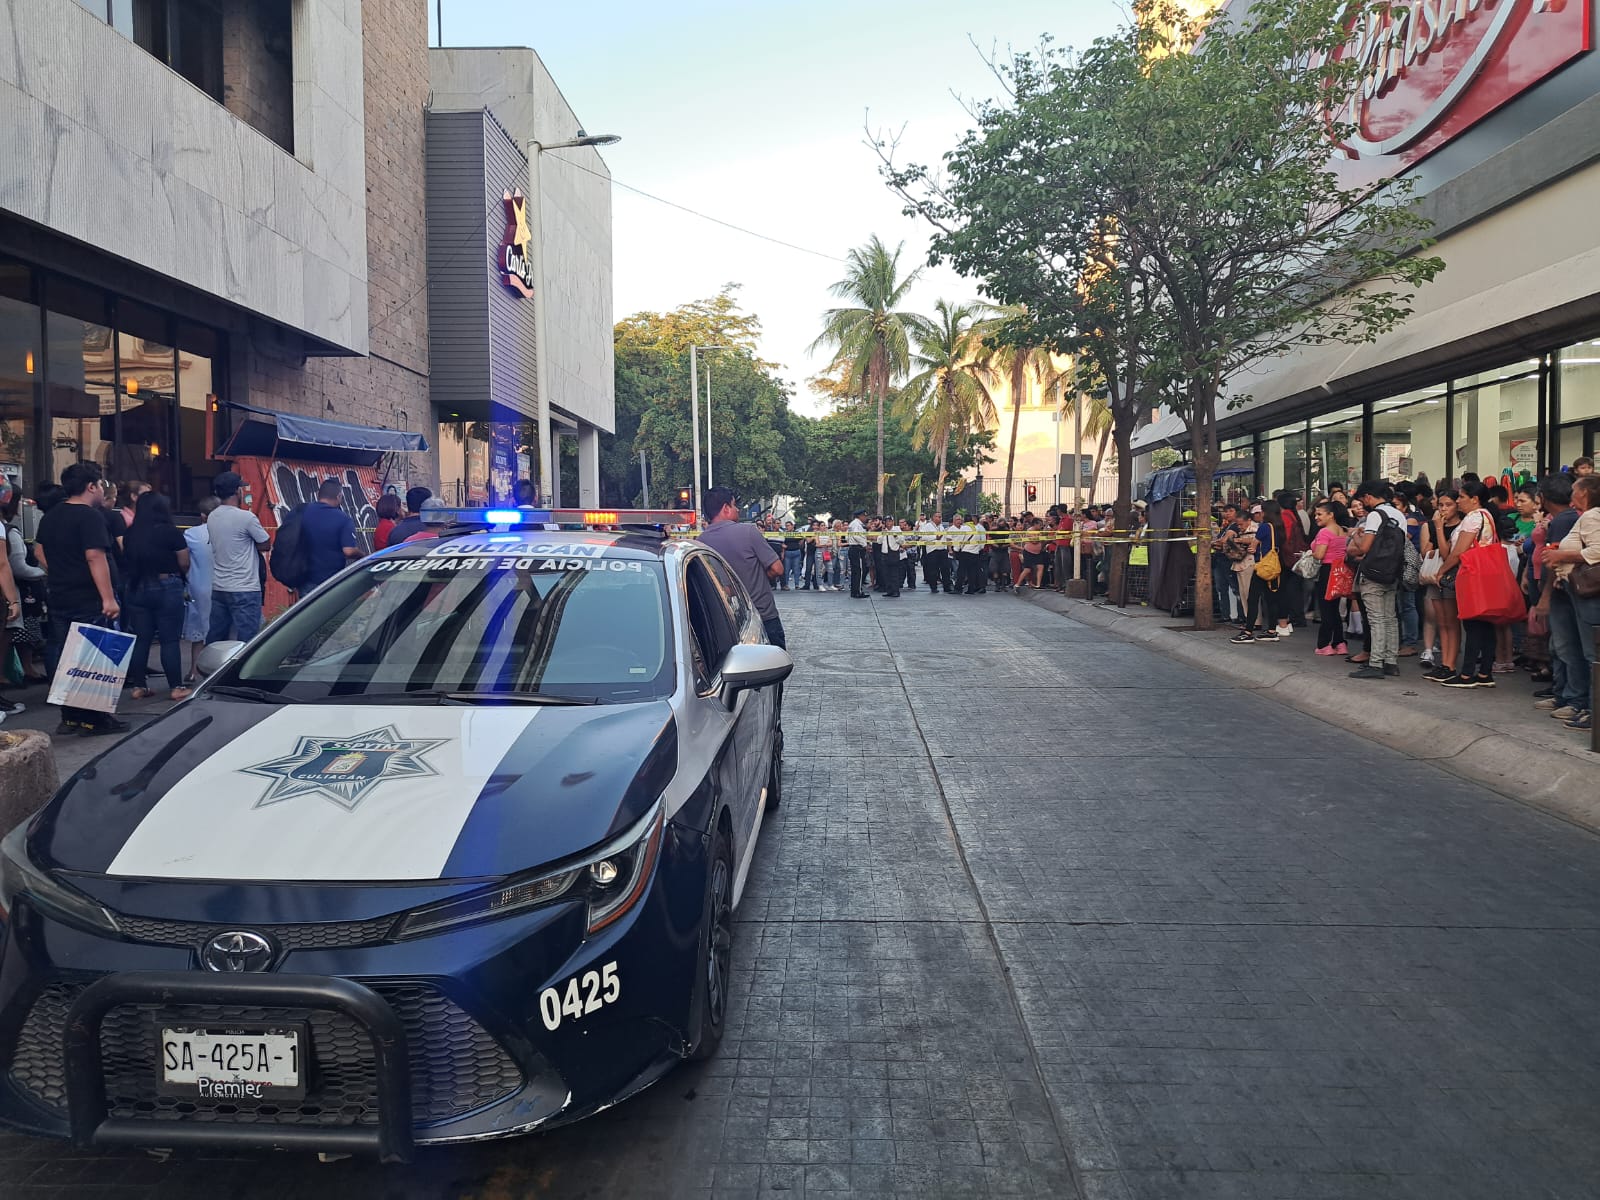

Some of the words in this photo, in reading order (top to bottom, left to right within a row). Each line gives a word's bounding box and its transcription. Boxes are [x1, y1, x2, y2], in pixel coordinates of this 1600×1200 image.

[539, 960, 620, 1031] 0425
[164, 1041, 297, 1073] SA-425A-1
[199, 1077, 263, 1098] Premier
